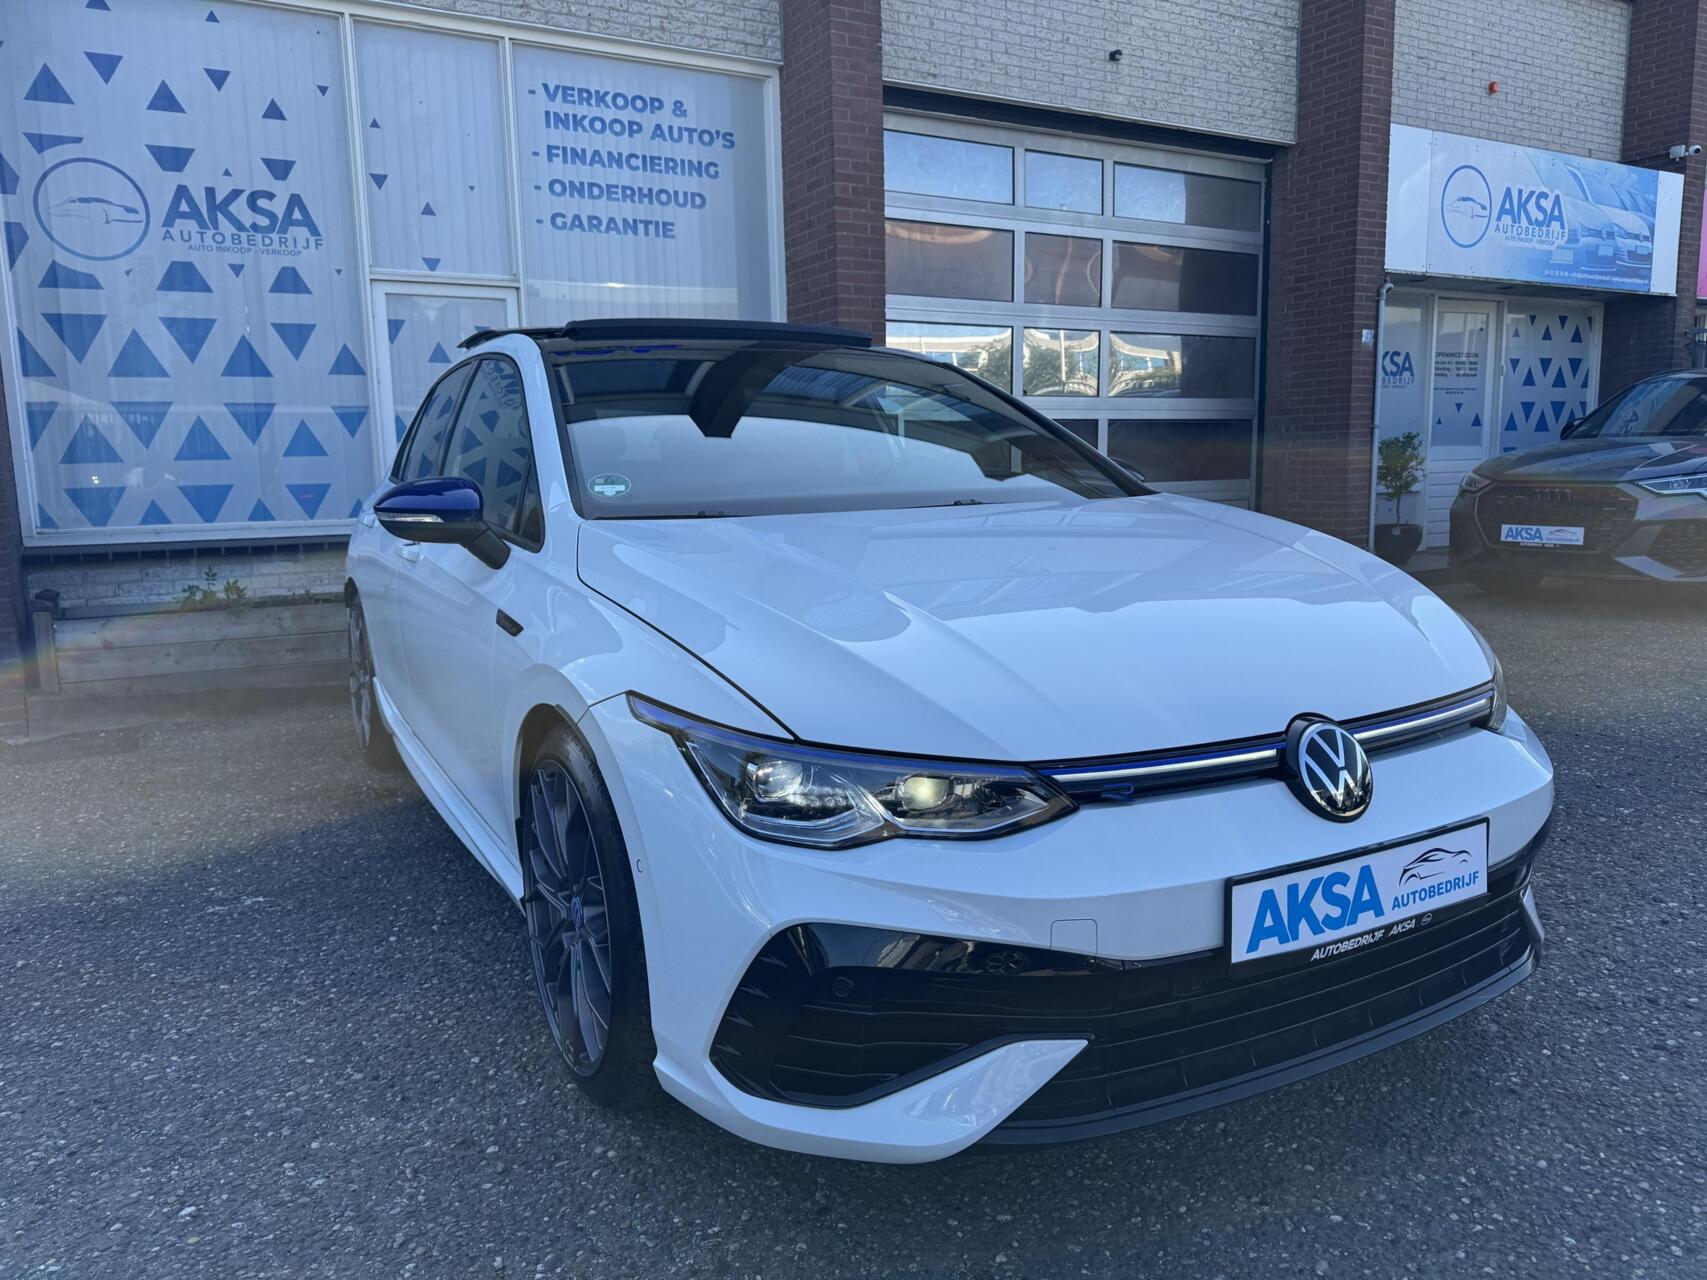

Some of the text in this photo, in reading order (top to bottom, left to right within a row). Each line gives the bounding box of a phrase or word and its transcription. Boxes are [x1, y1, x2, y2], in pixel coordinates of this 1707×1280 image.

[541, 83, 665, 114] VERKOOP
[672, 100, 688, 118] &
[544, 110, 643, 138] INKOOP
[546, 144, 720, 180] FINANCIERING
[161, 184, 322, 237] AKSA
[548, 178, 707, 210] ONDERHOUD
[1495, 186, 1566, 230] AKSA
[162, 229, 324, 250] AUTOBEDRIJF
[550, 212, 676, 239] GARANTIE
[1494, 223, 1567, 241] AUTOBEDRIJF
[187, 243, 214, 252] AUTO
[215, 246, 254, 255] INKOOP
[260, 248, 303, 257] VERKOOP
[1504, 526, 1544, 541] AKSA
[1391, 870, 1480, 912] AUTOBEDRIJF
[1245, 864, 1386, 954] AKSA
[1310, 919, 1417, 961] AUTOBEDRIJF AKSA
